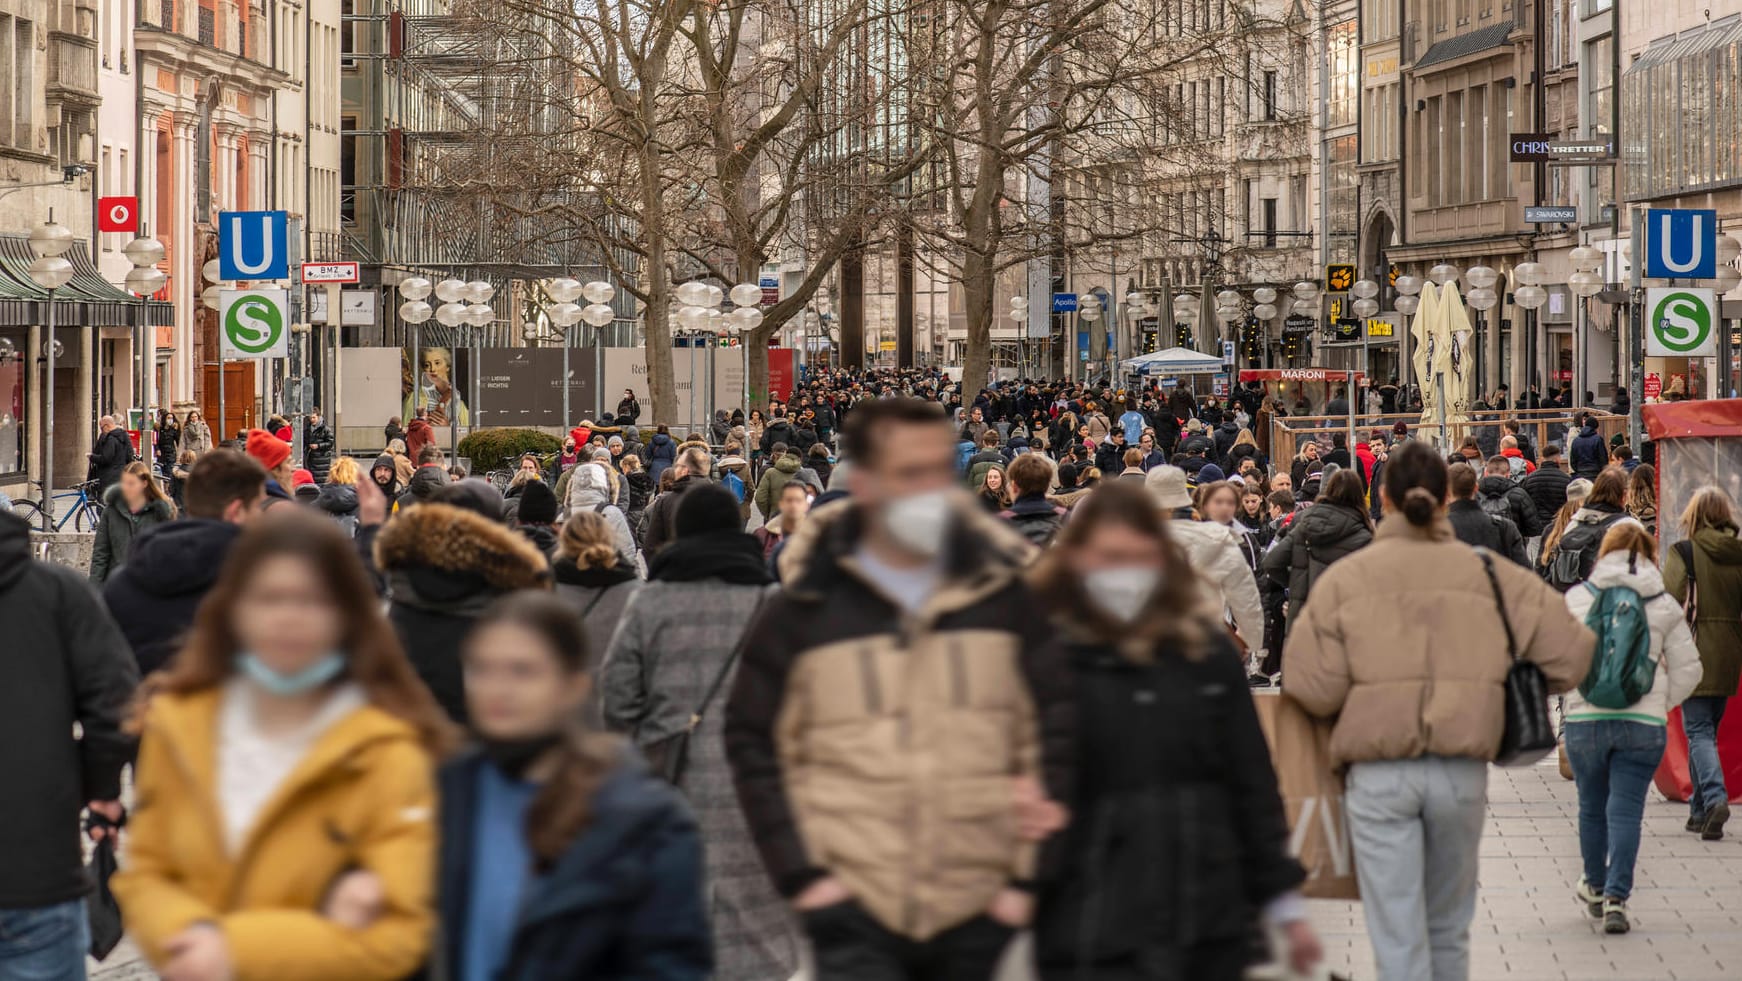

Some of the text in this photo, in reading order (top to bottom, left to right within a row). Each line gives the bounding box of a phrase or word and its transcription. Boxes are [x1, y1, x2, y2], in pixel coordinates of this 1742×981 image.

[1513, 141, 1550, 154] CHRIS
[1551, 145, 1605, 153] TRETTER
[1536, 210, 1574, 218] SWAROVSKI
[232, 216, 273, 275] U
[1661, 214, 1702, 273] U
[320, 266, 339, 274] BMZ
[1054, 298, 1077, 306] Apollo
[235, 301, 272, 347] S
[1663, 298, 1700, 345] S
[1281, 370, 1326, 379] MARONI
